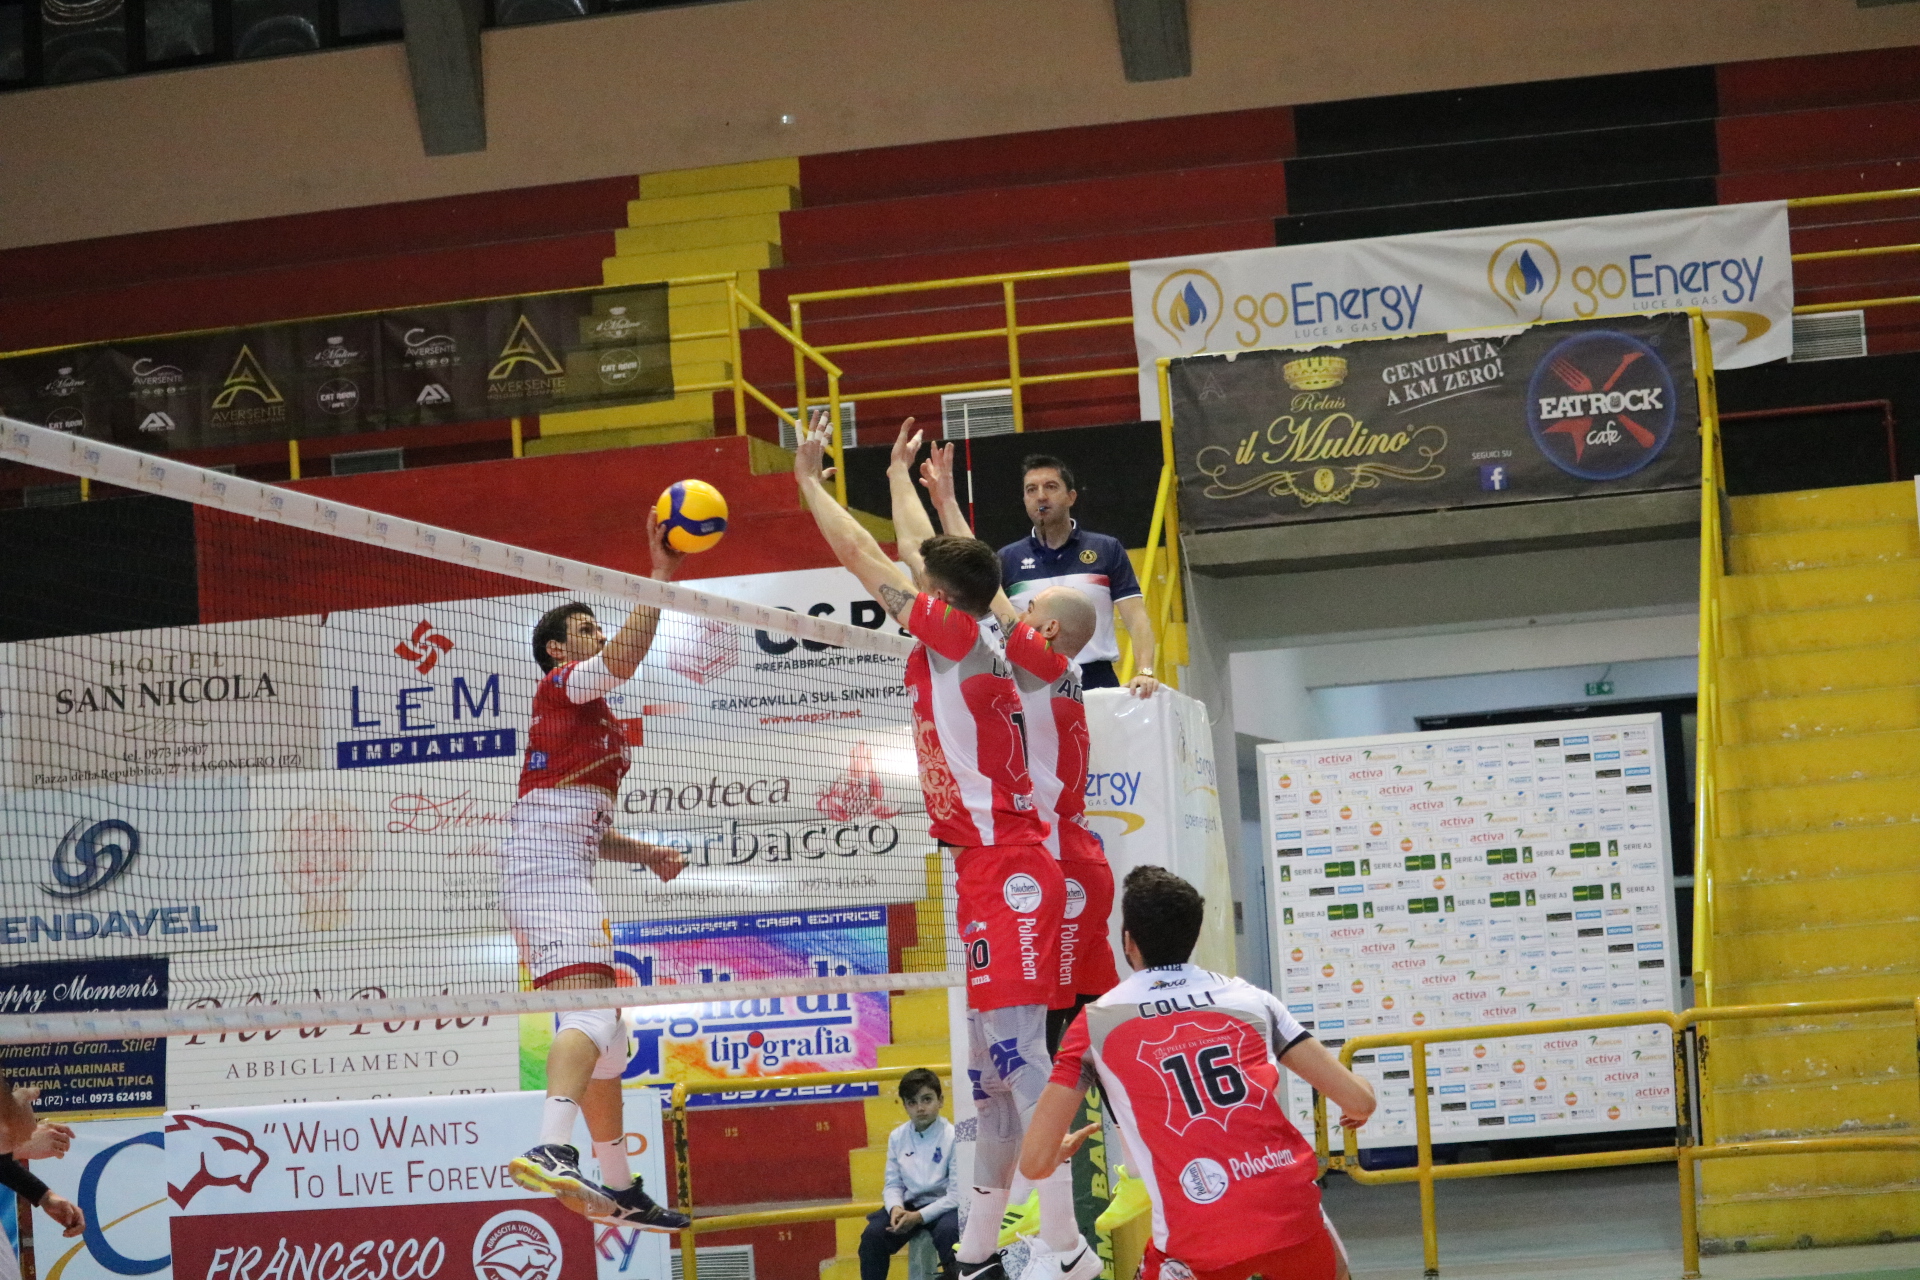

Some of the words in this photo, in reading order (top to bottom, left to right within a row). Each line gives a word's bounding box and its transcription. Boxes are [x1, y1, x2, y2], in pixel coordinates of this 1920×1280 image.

[1633, 299, 1667, 310] LUCE
[1691, 295, 1718, 306] GAS
[1295, 326, 1328, 339] LUCE
[1351, 322, 1378, 334] GAS
[405, 344, 456, 357] AVERSENTE
[133, 375, 183, 386] AVERSENTE
[489, 378, 566, 393] AVERSENTE
[1387, 389, 1400, 407] A
[1403, 378, 1438, 403] KM
[1444, 358, 1504, 393] ZERO!
[1290, 391, 1346, 413] Relais
[212, 406, 286, 422] AVERSENTE
[1235, 431, 1259, 465] il
[1262, 412, 1411, 465] Mulino
[1472, 450, 1500, 460] SEGUICI
[1502, 449, 1512, 458] SU
[109, 651, 225, 677] HOTEL
[755, 656, 846, 672] PREFABBRICATI
[56, 684, 126, 715] SAN
[138, 671, 278, 709] NICOLA
[711, 693, 807, 710] FRANCAVILLA
[811, 690, 838, 703] SUL
[842, 687, 879, 701] SINNI
[351, 672, 500, 731] LEM
[144, 747, 172, 761] 0973
[1318, 755, 1352, 764] activa
[34, 771, 68, 785] Piazza
[71, 769, 97, 782] della
[191, 755, 274, 773] LAGONEGRO
[278, 753, 303, 768] (PZ)
[1349, 769, 1383, 779] activa
[624, 776, 791, 815] enoteca
[1379, 785, 1413, 795] activa
[1409, 801, 1444, 810] activa
[1440, 816, 1474, 826] activa
[1470, 832, 1504, 842] activa
[628, 820, 899, 872] erbacco
[1536, 850, 1554, 858] SERIE
[1503, 871, 1537, 880] activa
[1066, 888, 1082, 898] ochem
[756, 915, 801, 929] CASA
[807, 911, 881, 925] EDITRICE
[1331, 928, 1364, 937] activa
[1017, 918, 1039, 980] Polochem
[1060, 924, 1079, 985] Polochem
[1361, 943, 1395, 953] activa
[1392, 958, 1426, 968] activa
[53, 974, 159, 1001] Moments
[1422, 975, 1456, 985] activa
[1452, 991, 1487, 1000] activa
[1138, 991, 1216, 1020] COLLI
[1483, 1007, 1517, 1017] activa
[55, 1041, 68, 1055] in
[1543, 1039, 1578, 1049] activa
[226, 1050, 460, 1080] ABBIGLIAMENTO
[1586, 1054, 1621, 1064] activa
[64, 1062, 124, 1075] MARINARE
[70, 1076, 114, 1089] CUCINA
[117, 1074, 154, 1087] TIPICA
[1161, 1043, 1248, 1119] 16
[1605, 1072, 1639, 1081] activa
[44, 1094, 63, 1107] (PZ)
[71, 1093, 87, 1104] tel.
[90, 1091, 114, 1103] 0973
[116, 1089, 153, 1102] 624198
[1635, 1087, 1670, 1097] activa
[1228, 1145, 1297, 1181] Polochem
[407, 1159, 514, 1194] FOREVE
[486, 1224, 517, 1249] RINASCITA
[518, 1224, 542, 1241] VOLLEY
[205, 1236, 446, 1280] FRANCESCO
